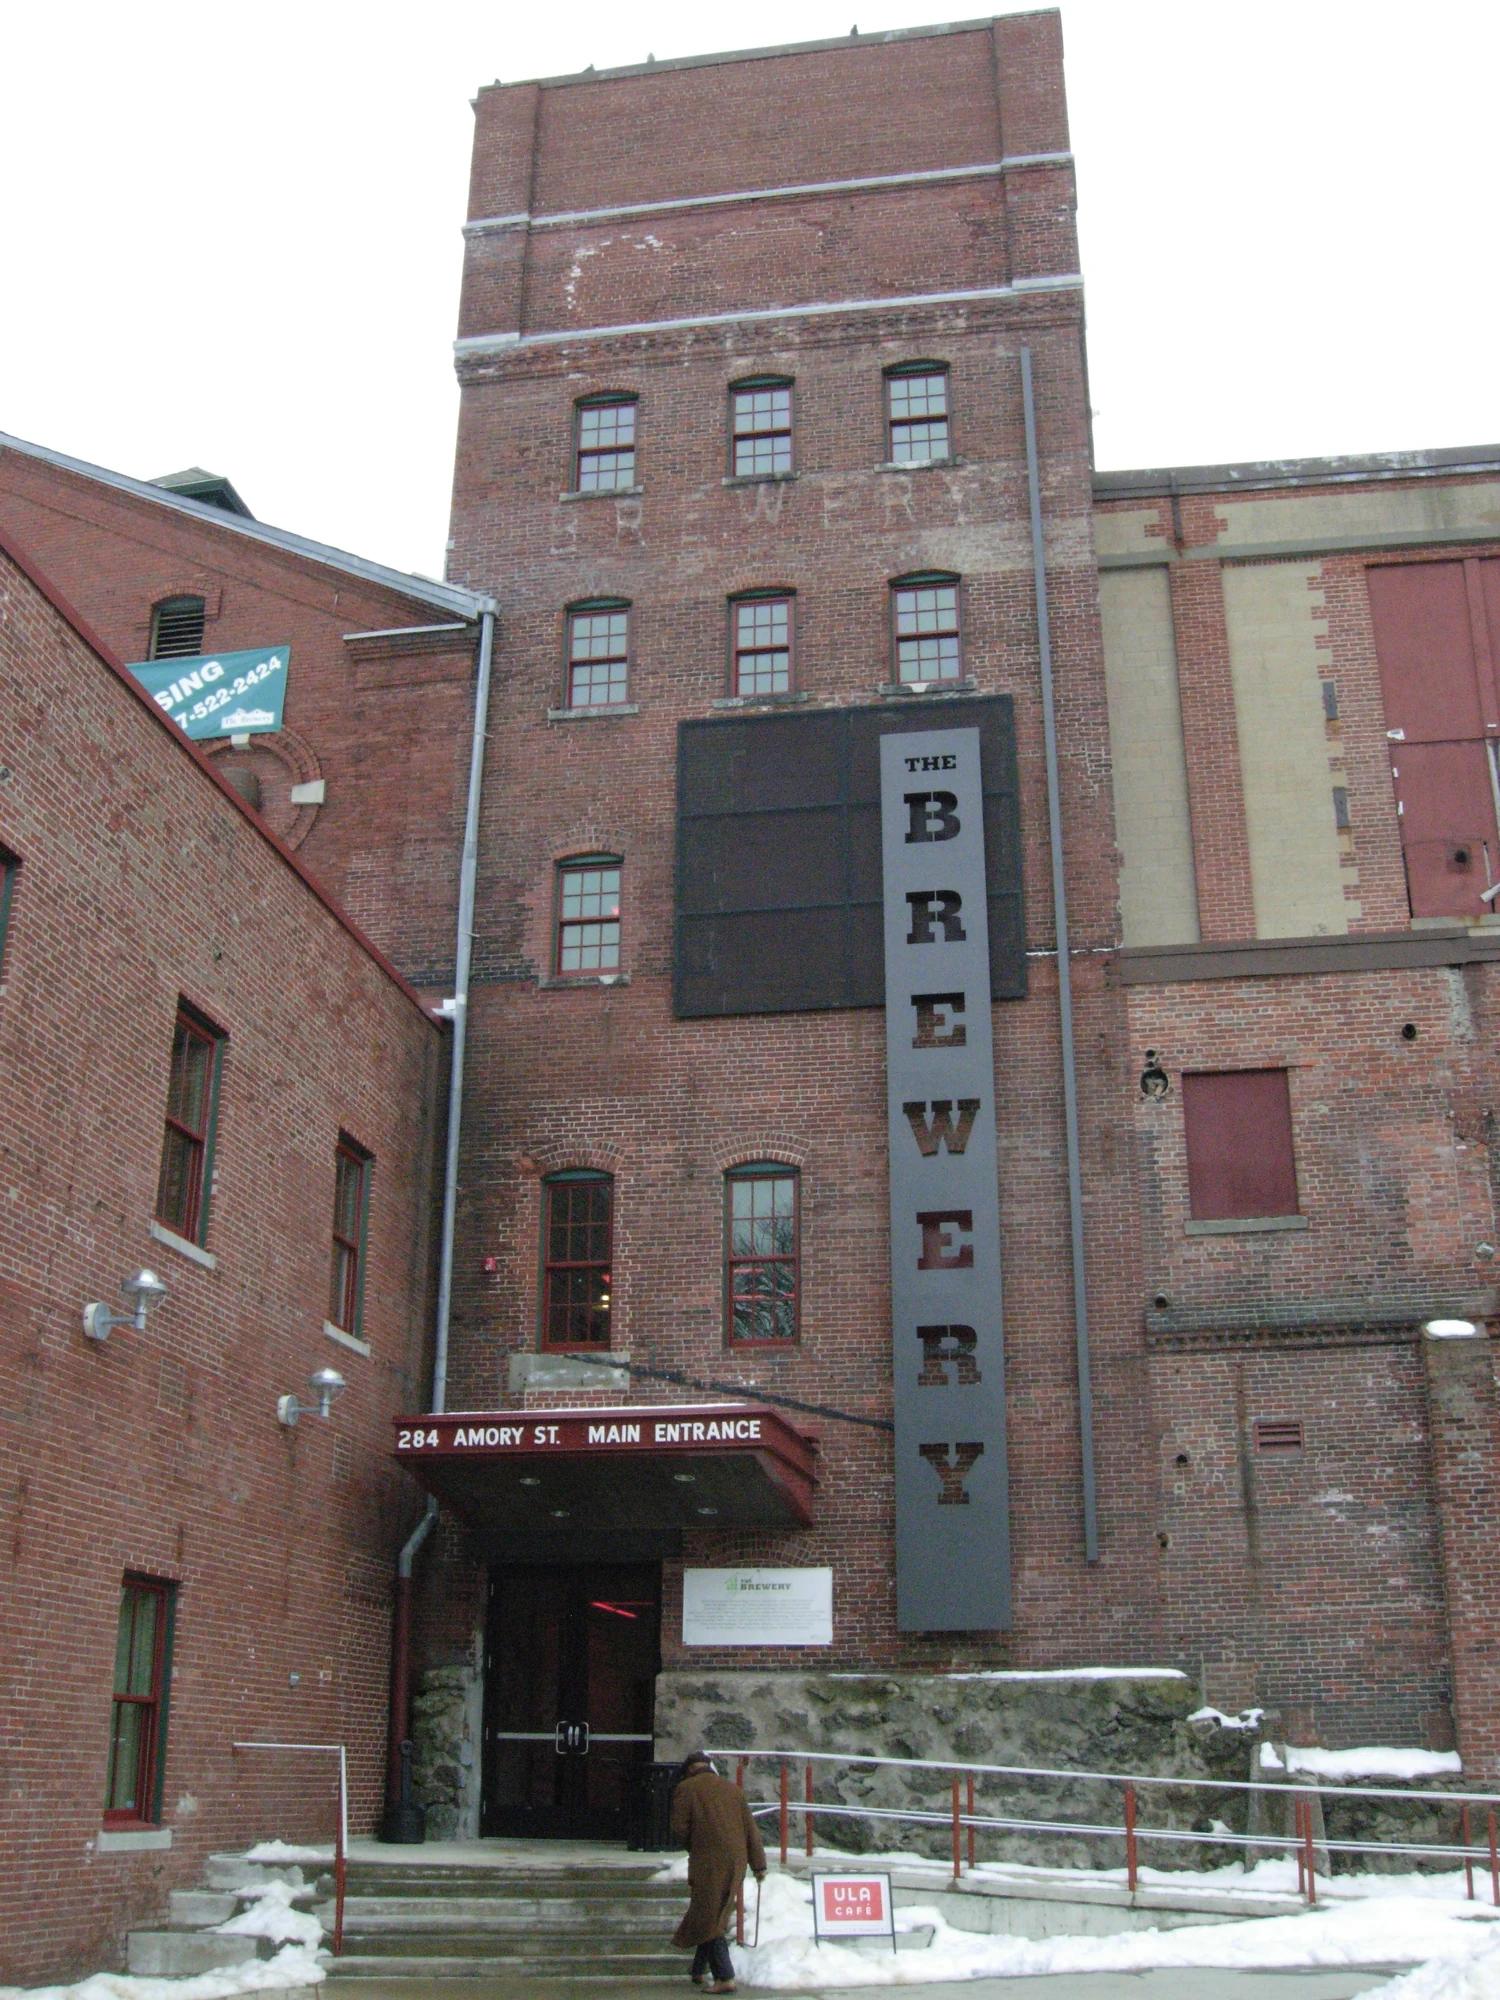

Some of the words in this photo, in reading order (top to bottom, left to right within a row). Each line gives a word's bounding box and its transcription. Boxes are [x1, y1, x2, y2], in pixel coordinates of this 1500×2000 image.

[153, 661, 224, 711] SING
[905, 755, 957, 772] THE
[903, 791, 984, 1505] BREWERY
[399, 1429, 439, 1448] 284
[453, 1426, 523, 1447] AMORY
[534, 1425, 561, 1445] ST.
[588, 1424, 640, 1443] MAIN
[655, 1420, 762, 1443] ENTRANCE
[740, 1583, 792, 1591] BREWERY
[834, 1887, 871, 1901] ULA
